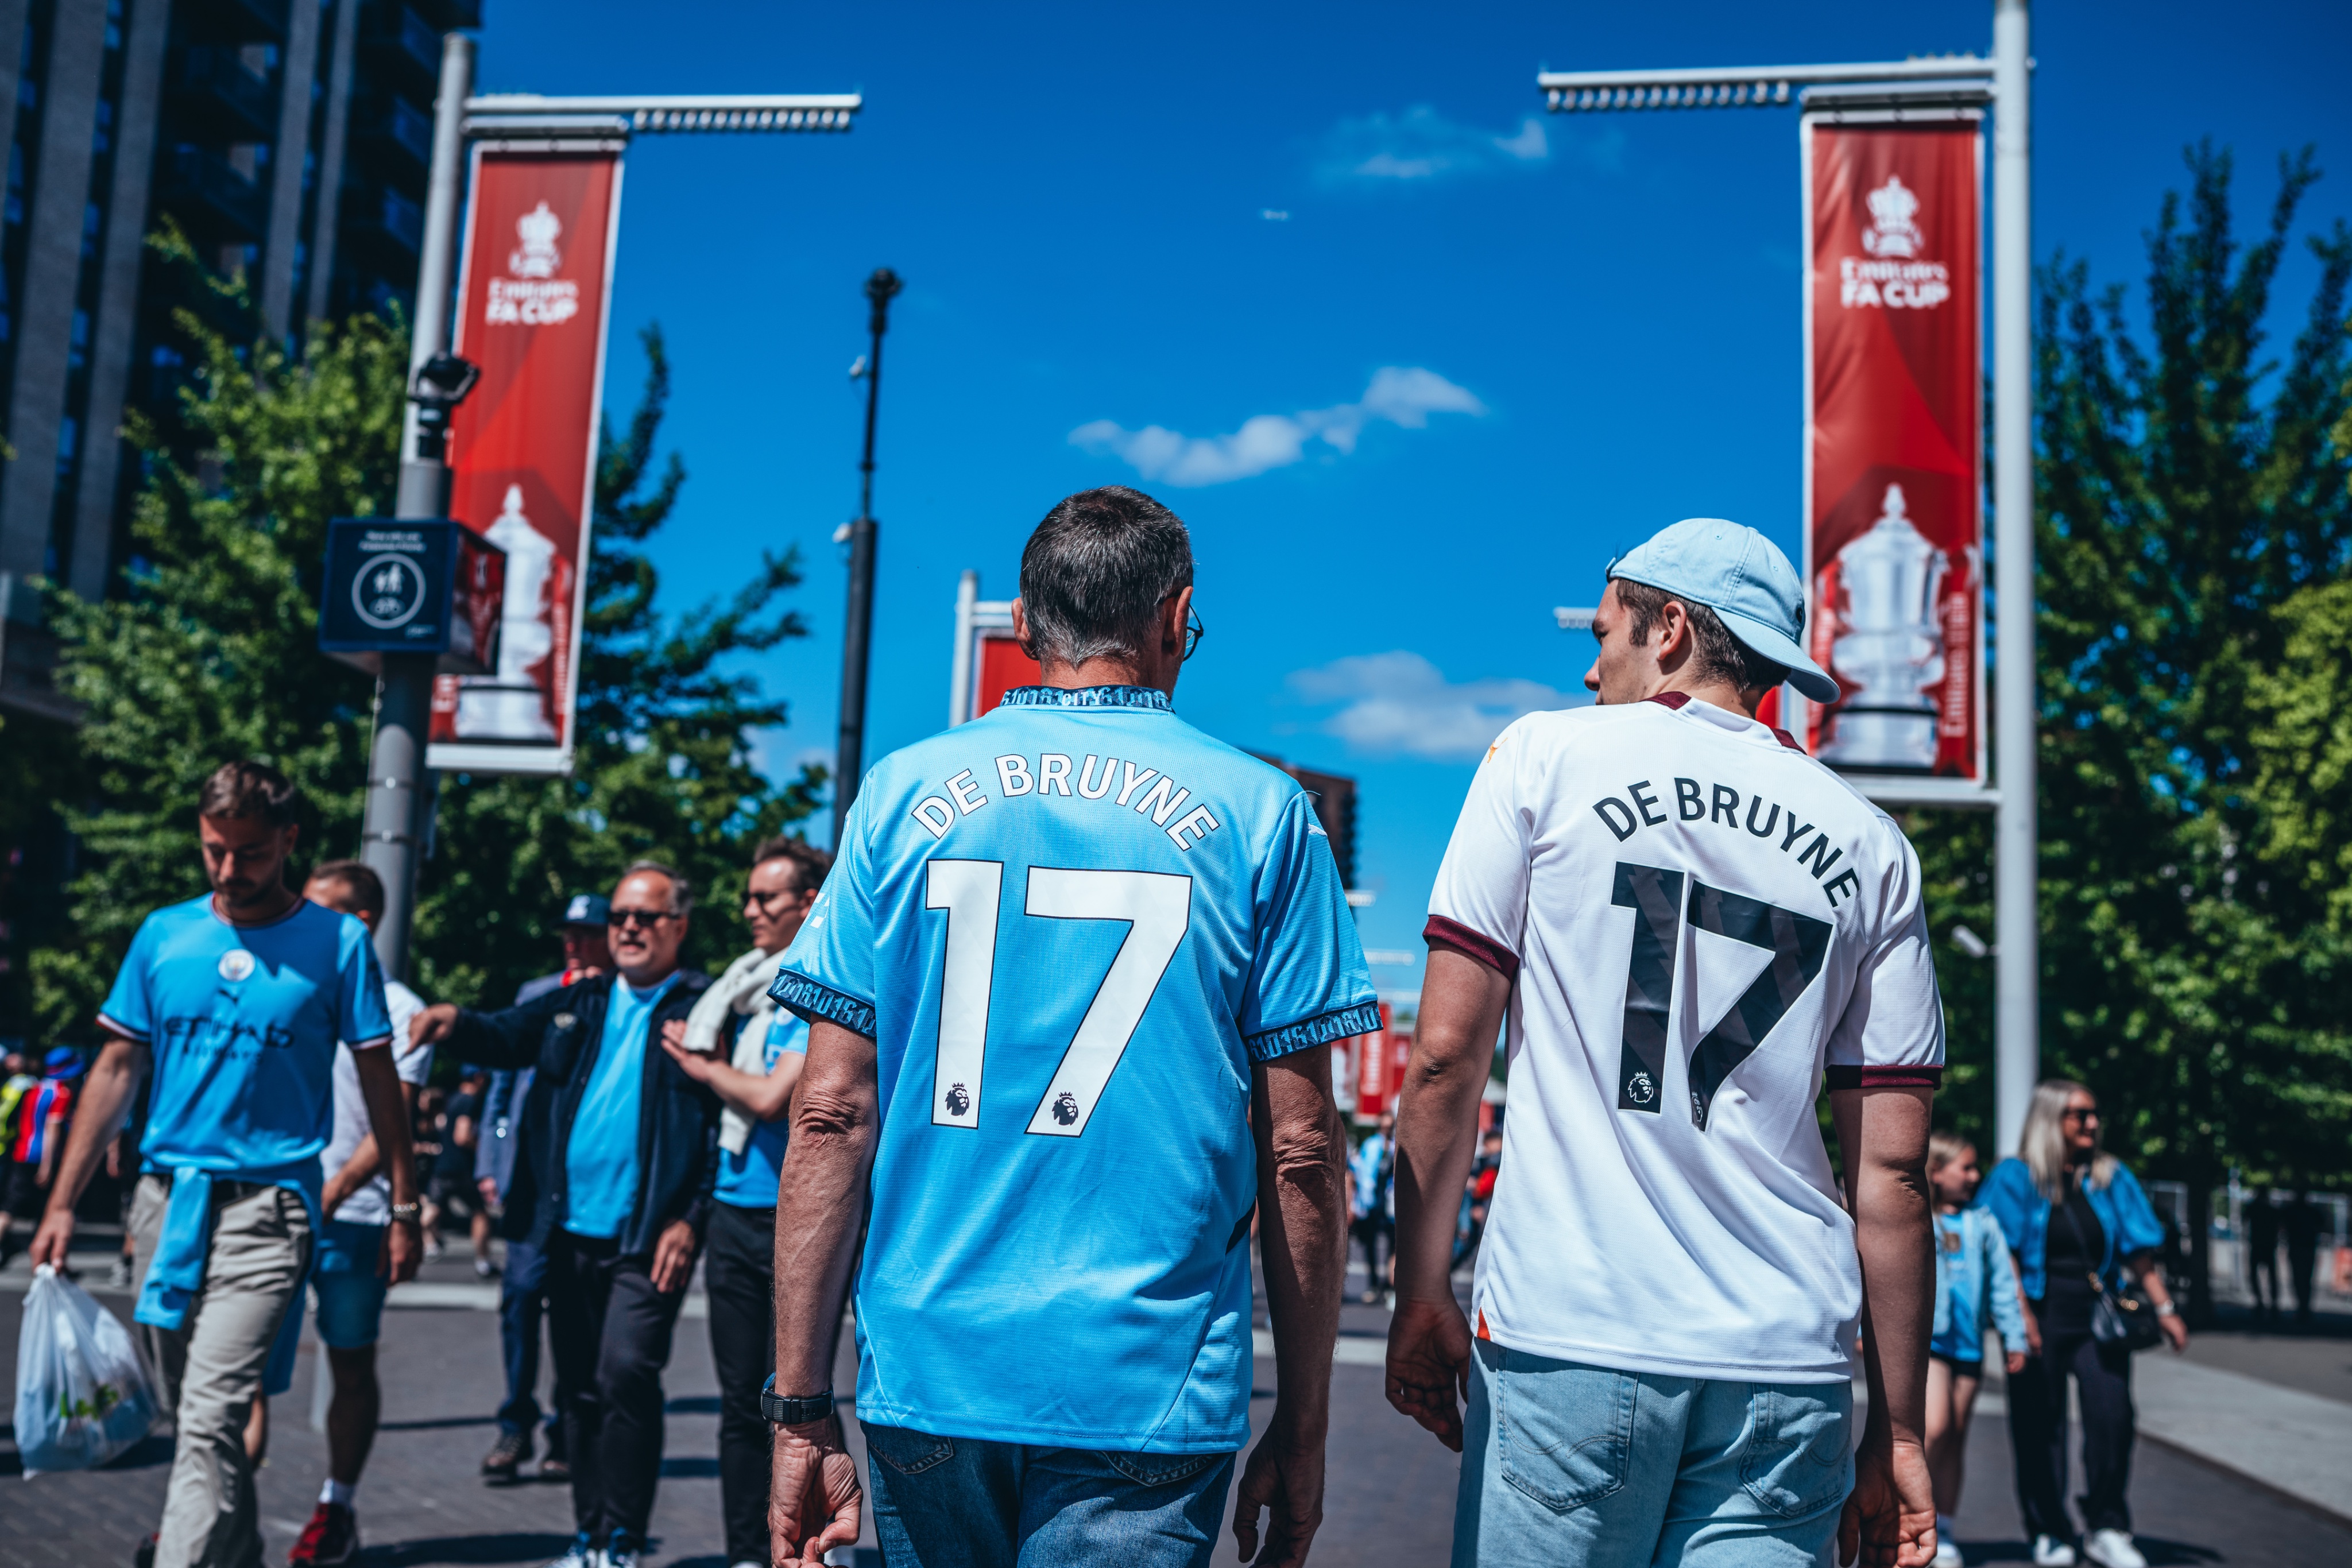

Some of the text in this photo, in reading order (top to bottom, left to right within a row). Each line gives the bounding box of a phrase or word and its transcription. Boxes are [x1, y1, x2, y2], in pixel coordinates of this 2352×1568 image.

[486, 297, 579, 325] FA CUP
[1840, 280, 1951, 308] FA CUP
[911, 753, 1220, 851] DE BRUYNE
[1592, 777, 1860, 908] DE BRUYNE
[926, 858, 1193, 1137] 17
[1610, 861, 1834, 1132] 17
